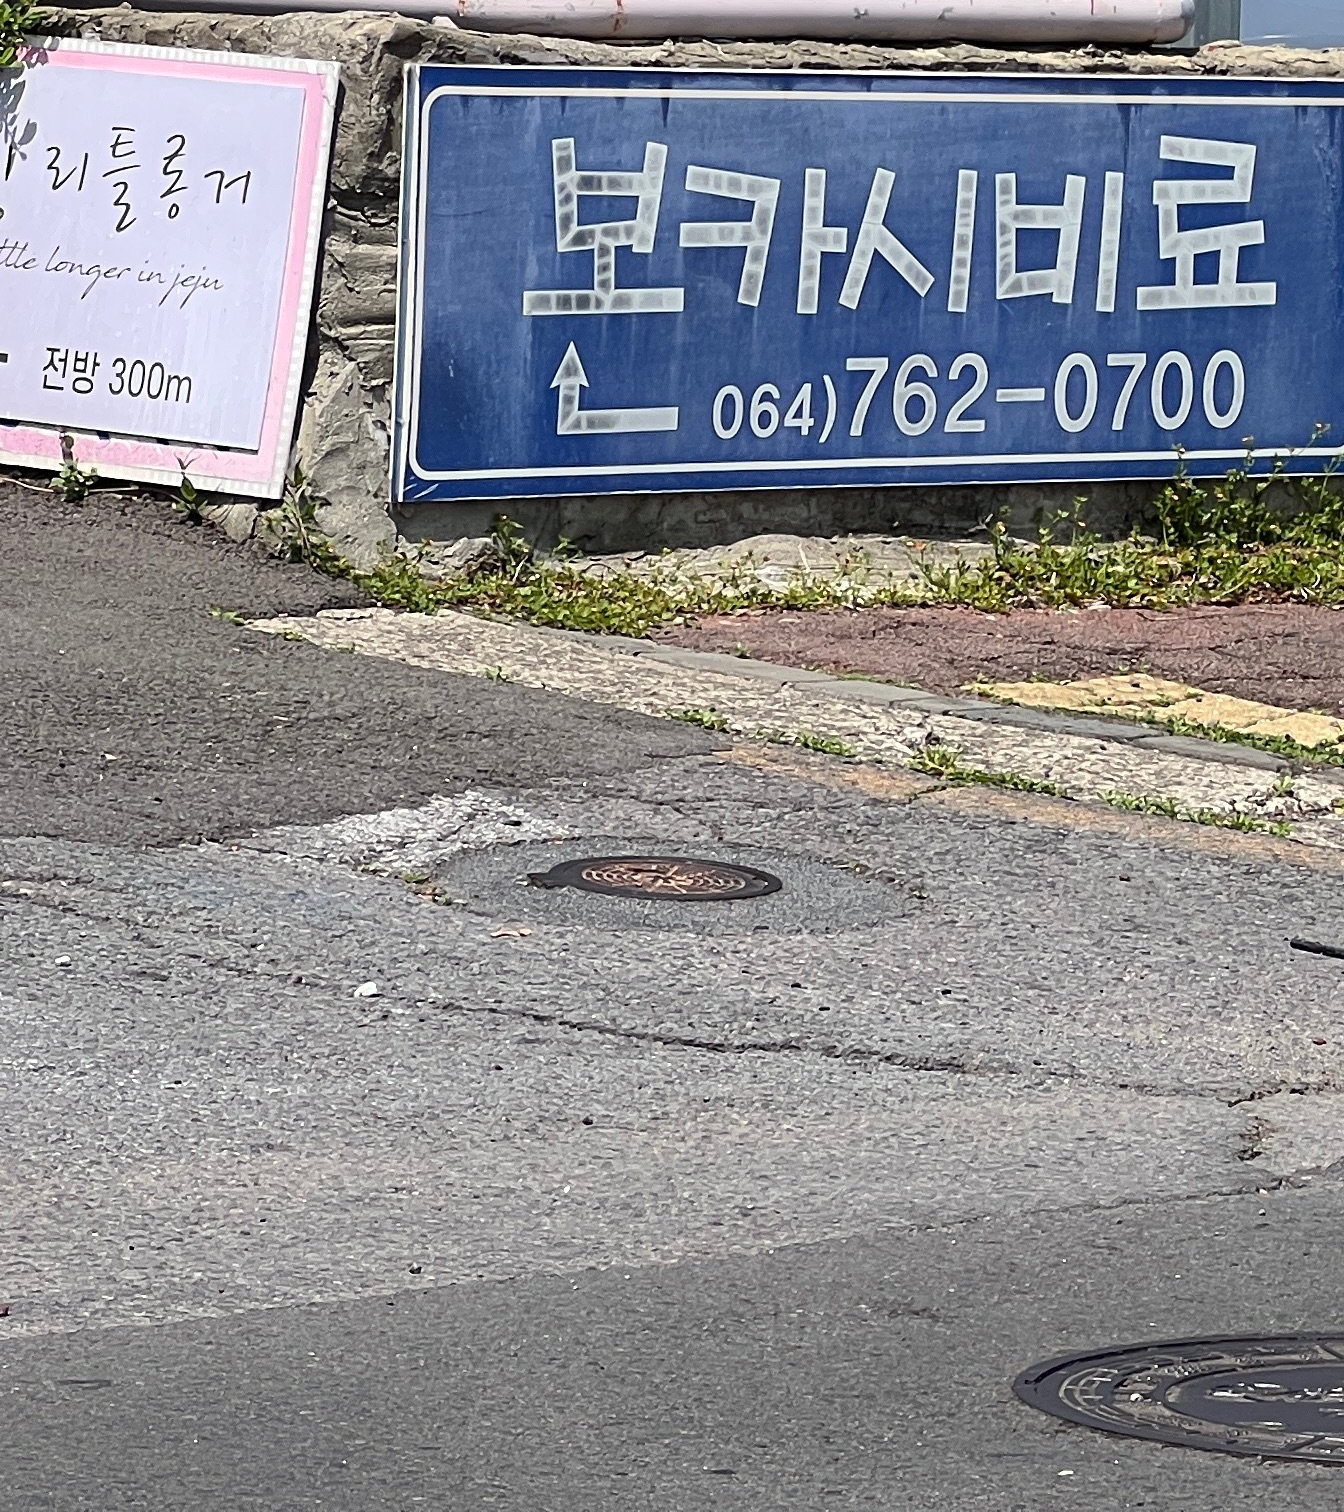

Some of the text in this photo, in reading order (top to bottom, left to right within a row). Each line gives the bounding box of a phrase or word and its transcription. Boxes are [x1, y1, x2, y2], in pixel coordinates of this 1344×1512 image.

[523, 134, 1277, 316] 보카시비료
[45, 246, 131, 300] longer
[137, 260, 165, 284] in
[158, 264, 224, 310] jeju
[42, 347, 193, 404] 전방 300m
[712, 349, 1246, 444] 064)762-0700
